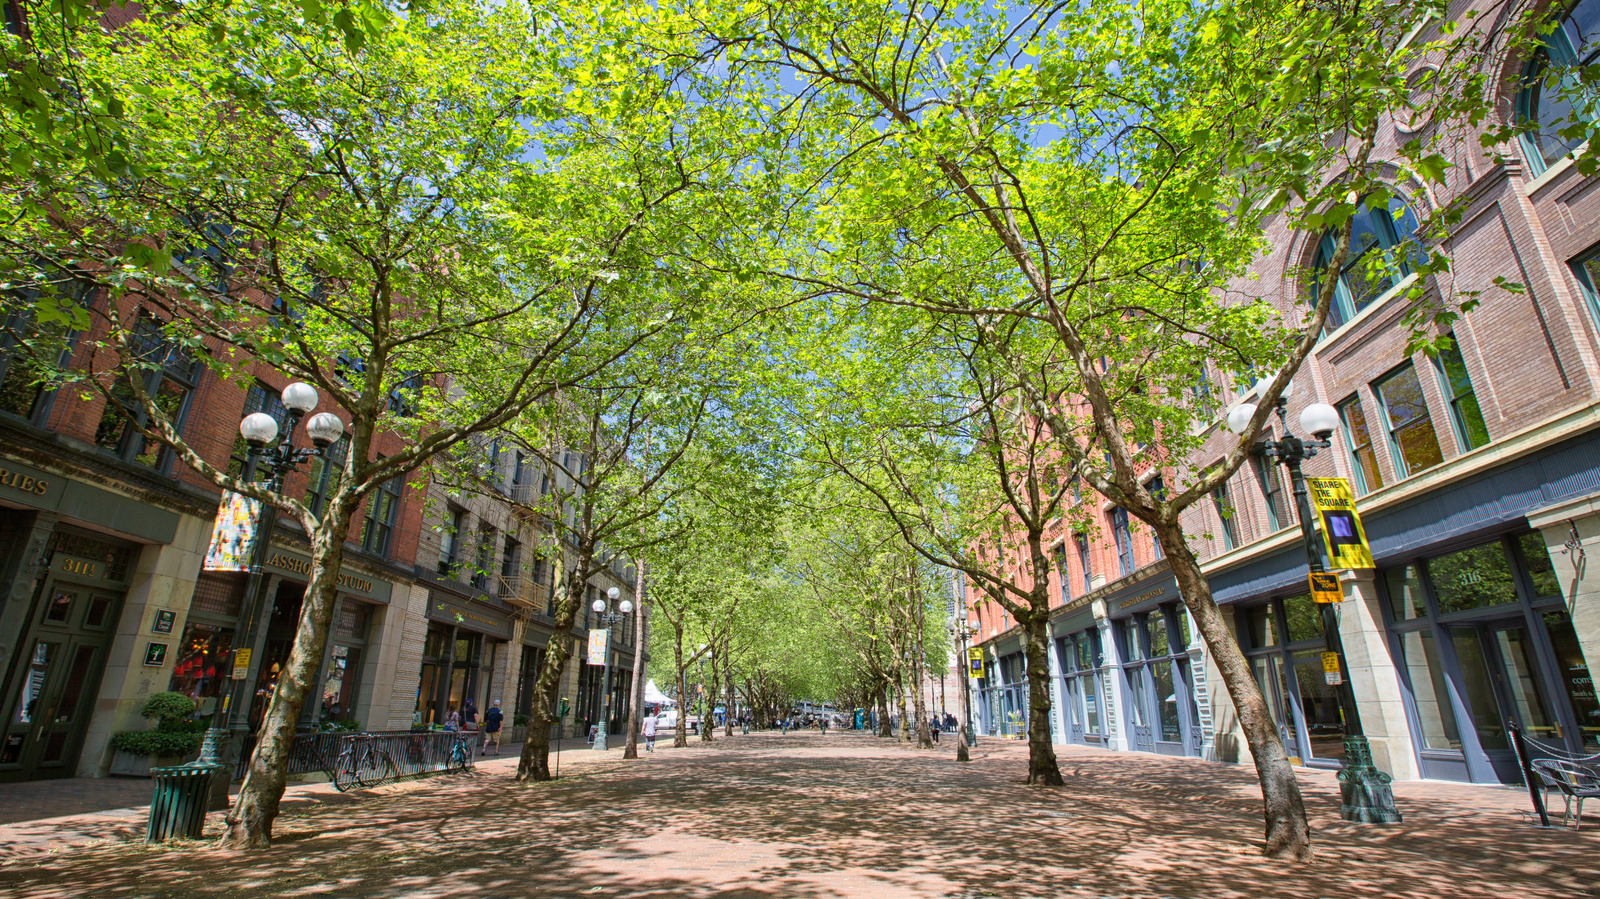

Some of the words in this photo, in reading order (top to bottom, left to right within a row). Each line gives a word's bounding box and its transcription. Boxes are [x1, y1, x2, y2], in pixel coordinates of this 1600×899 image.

[1312, 481, 1339, 489] SHARE
[1319, 499, 1350, 507] SQUARE
[337, 572, 373, 593] STUDIO
[1459, 570, 1481, 586] 316
